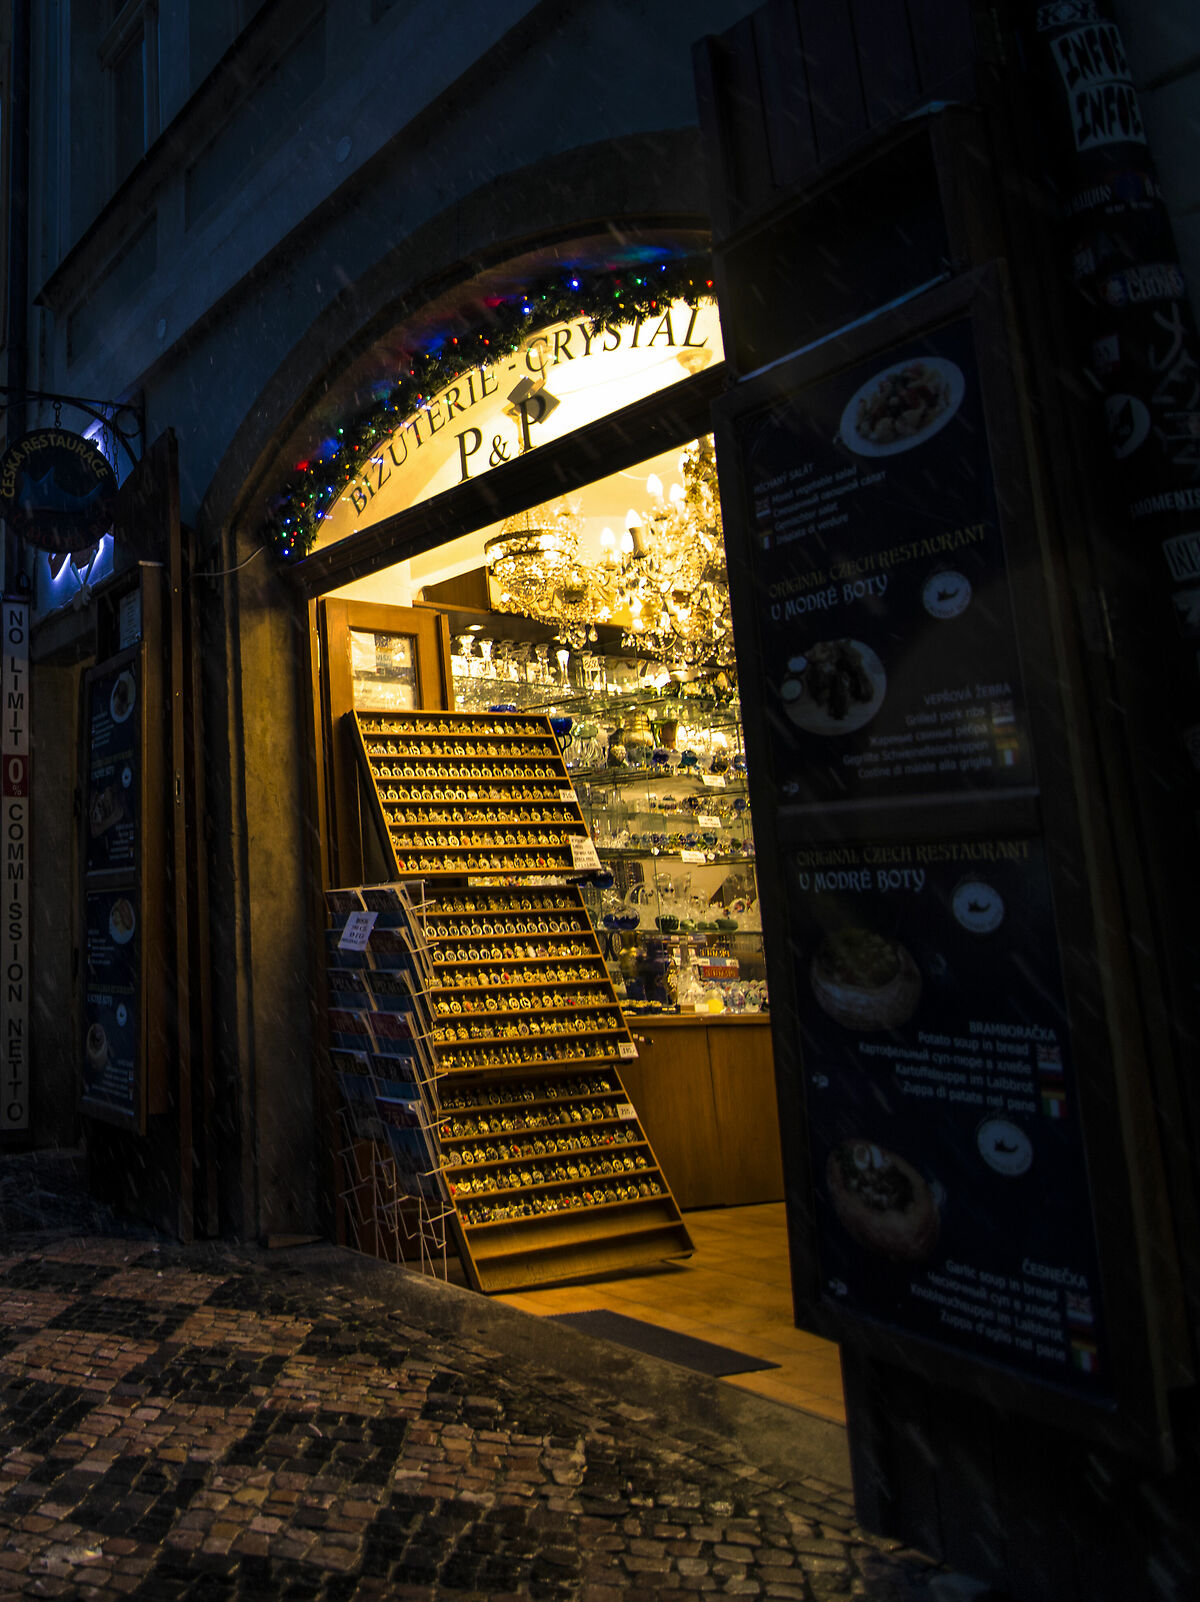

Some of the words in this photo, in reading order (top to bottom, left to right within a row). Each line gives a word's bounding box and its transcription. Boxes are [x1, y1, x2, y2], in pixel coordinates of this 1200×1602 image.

[525, 309, 709, 373] CRYSTAL
[454, 427, 482, 484] P
[488, 434, 512, 468] &
[518, 398, 547, 452] P
[0, 448, 25, 498] ČESKÁ
[21, 434, 109, 480] RESTAURACE
[829, 556, 876, 580] CZECH
[878, 524, 984, 569] RESTAURANT
[770, 604, 781, 621] U
[784, 586, 838, 621] MODRÉ
[843, 574, 888, 605] BOTY
[9, 610, 23, 644] NO
[8, 657, 24, 746] LIMIT
[863, 845, 915, 864] CZECH
[916, 840, 1029, 864] RESTAURANT
[7, 804, 24, 1002] COMMISSION
[799, 872, 810, 891] U
[813, 868, 872, 892] MODRÉ
[877, 868, 925, 892] BOTY
[918, 1031, 951, 1047] Potato
[953, 1037, 979, 1052] soup
[982, 1039, 993, 1050] in
[969, 1020, 1056, 1041] BRAMBORAČKA
[8, 1019, 23, 1121] NETTO
[903, 1081, 934, 1097] Zuppa
[969, 1073, 984, 1085] im
